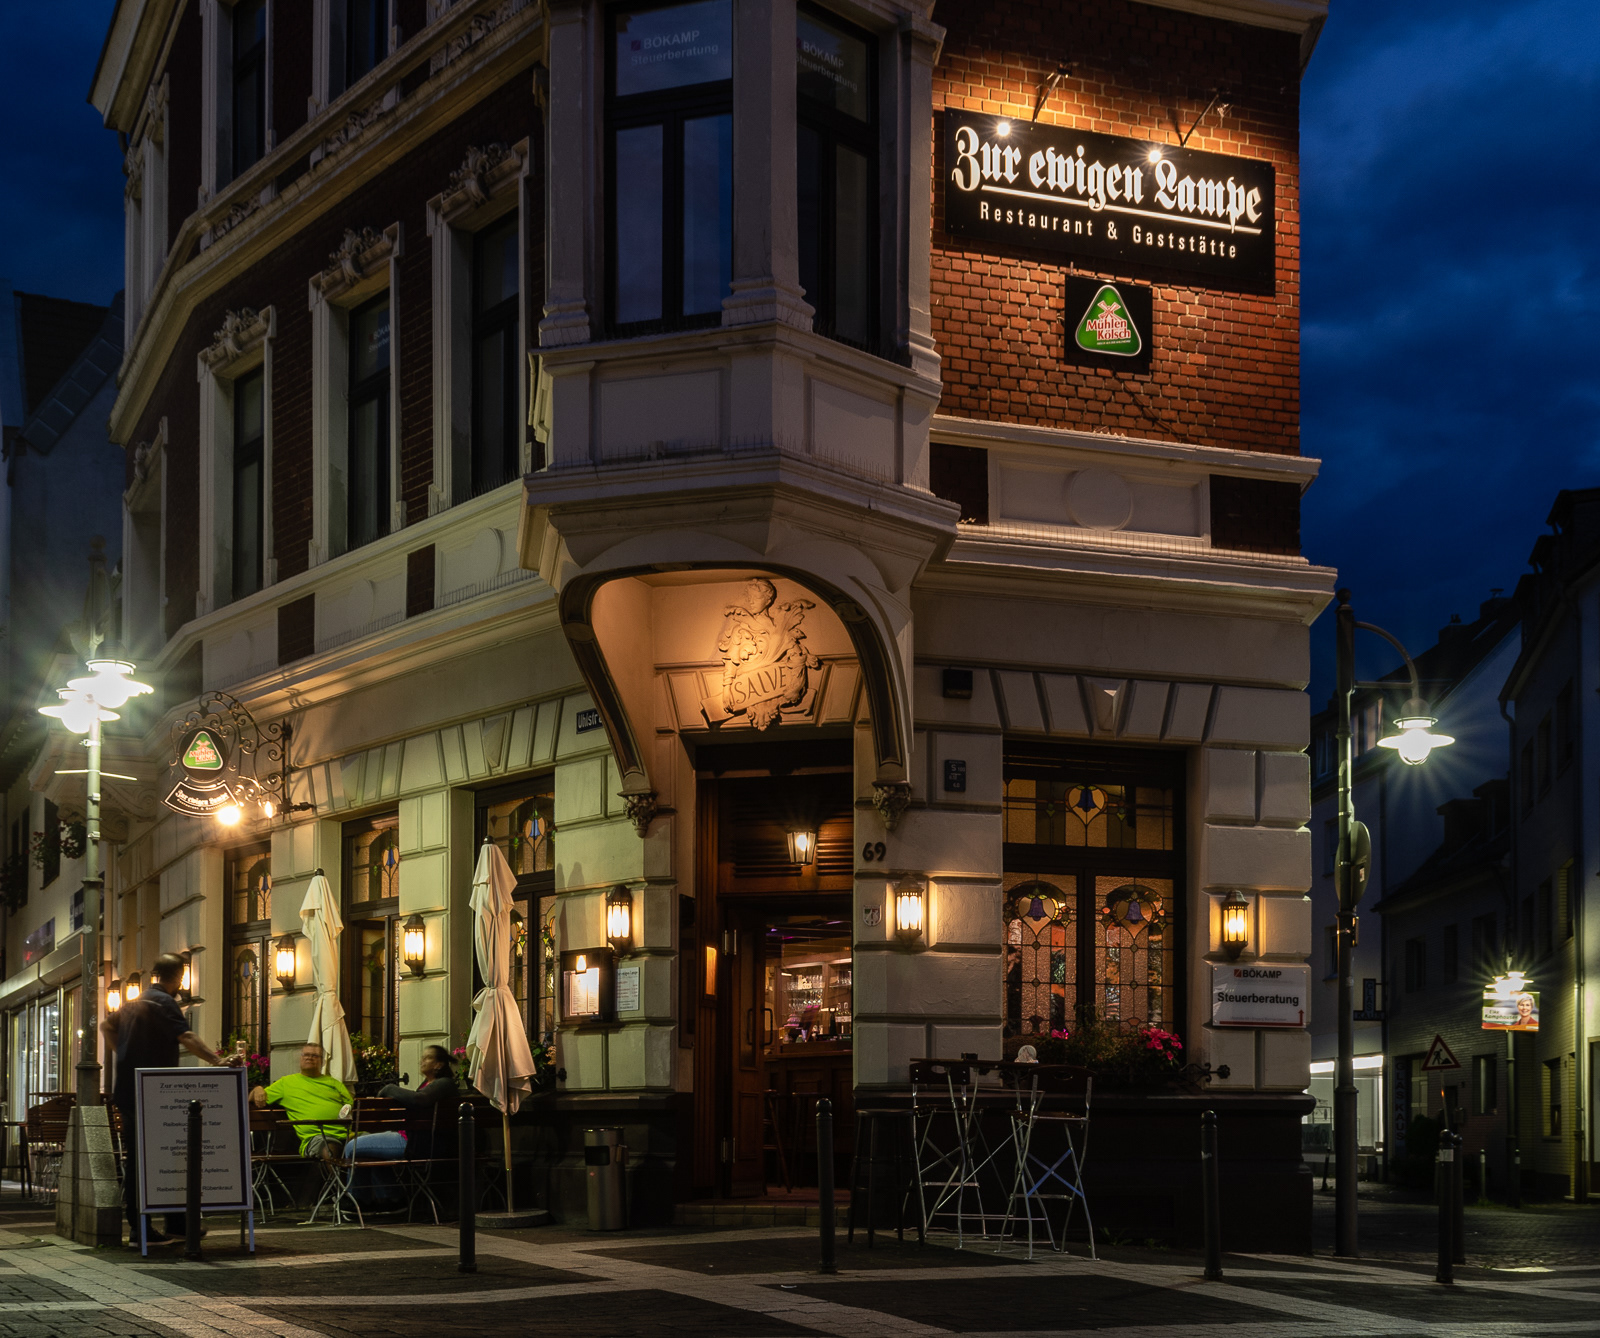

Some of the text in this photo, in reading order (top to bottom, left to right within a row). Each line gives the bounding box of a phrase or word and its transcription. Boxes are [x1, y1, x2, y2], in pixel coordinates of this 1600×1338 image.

[631, 44, 719, 66] Steuerberatung
[952, 126, 1262, 233] Zur ewigen Lampe
[981, 201, 1236, 258] Restaurant & Gaststätte
[1087, 318, 1127, 331] Mühlen
[1097, 329, 1131, 340] Kölsch
[734, 666, 787, 704] SALVE
[862, 841, 887, 862] 69
[1242, 968, 1282, 978] BÖKAMP
[1217, 992, 1300, 1006] Steuerberatung
[1396, 1062, 1406, 1141] GLAS KAUS
